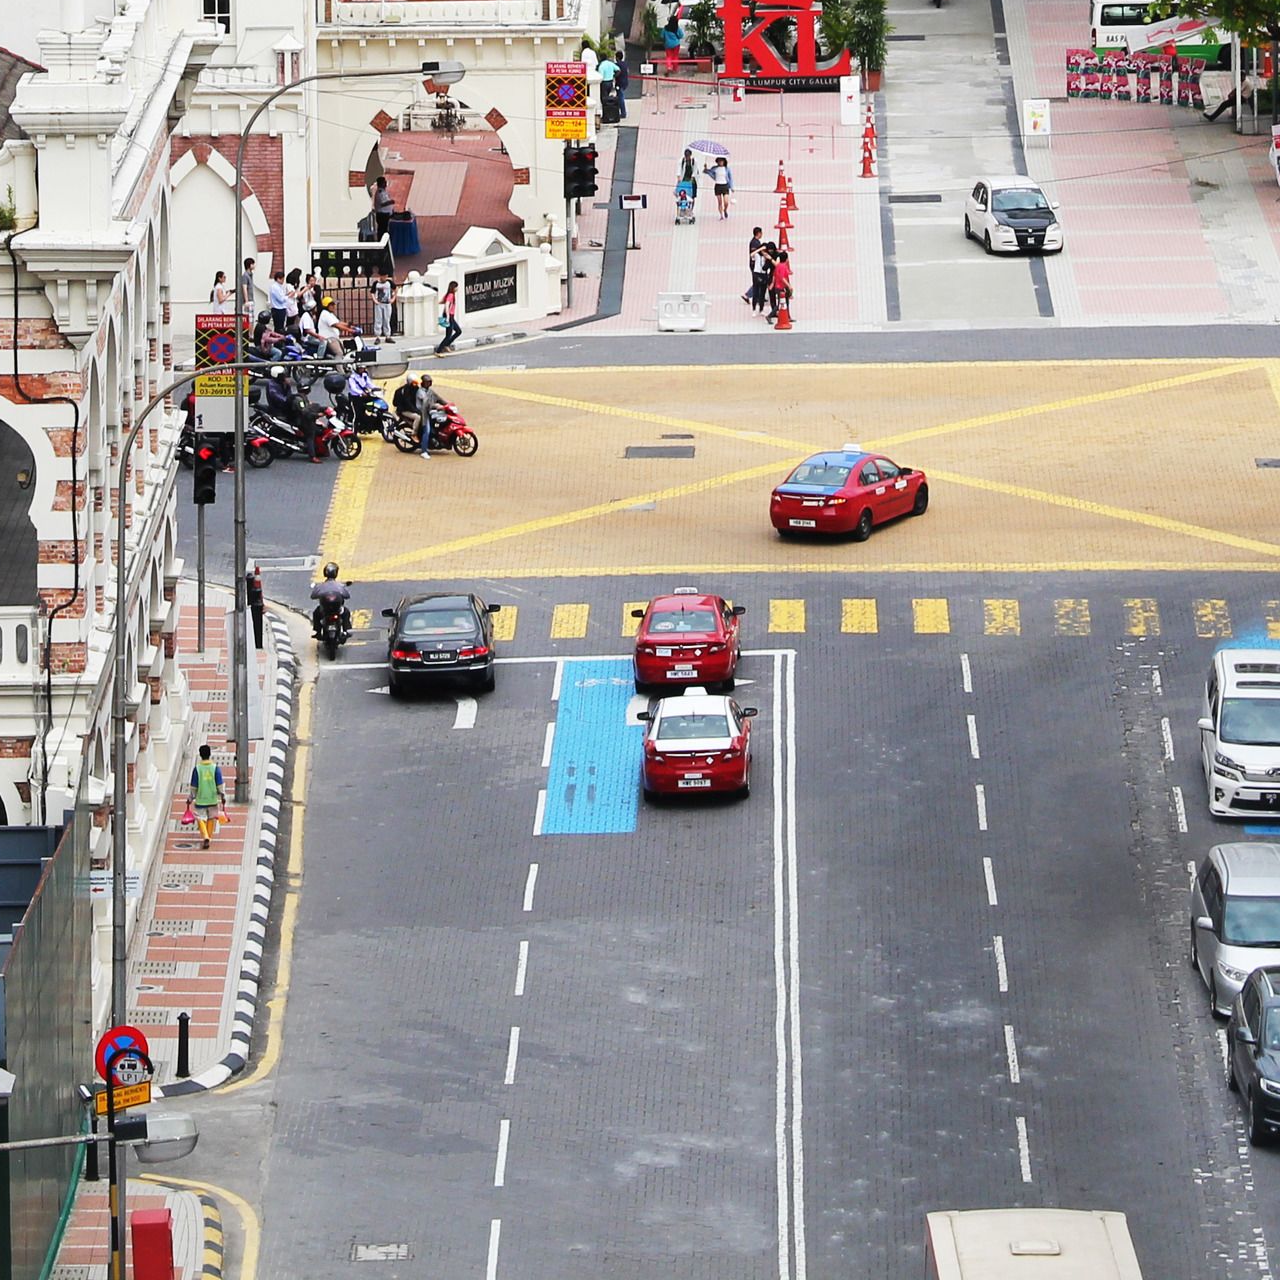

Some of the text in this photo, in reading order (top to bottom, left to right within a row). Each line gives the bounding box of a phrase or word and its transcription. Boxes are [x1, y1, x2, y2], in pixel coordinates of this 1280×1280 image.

[753, 78, 786, 86] LUMPUR
[789, 78, 807, 86] CITY
[465, 276, 515, 295] MUZIUM MUZIK
